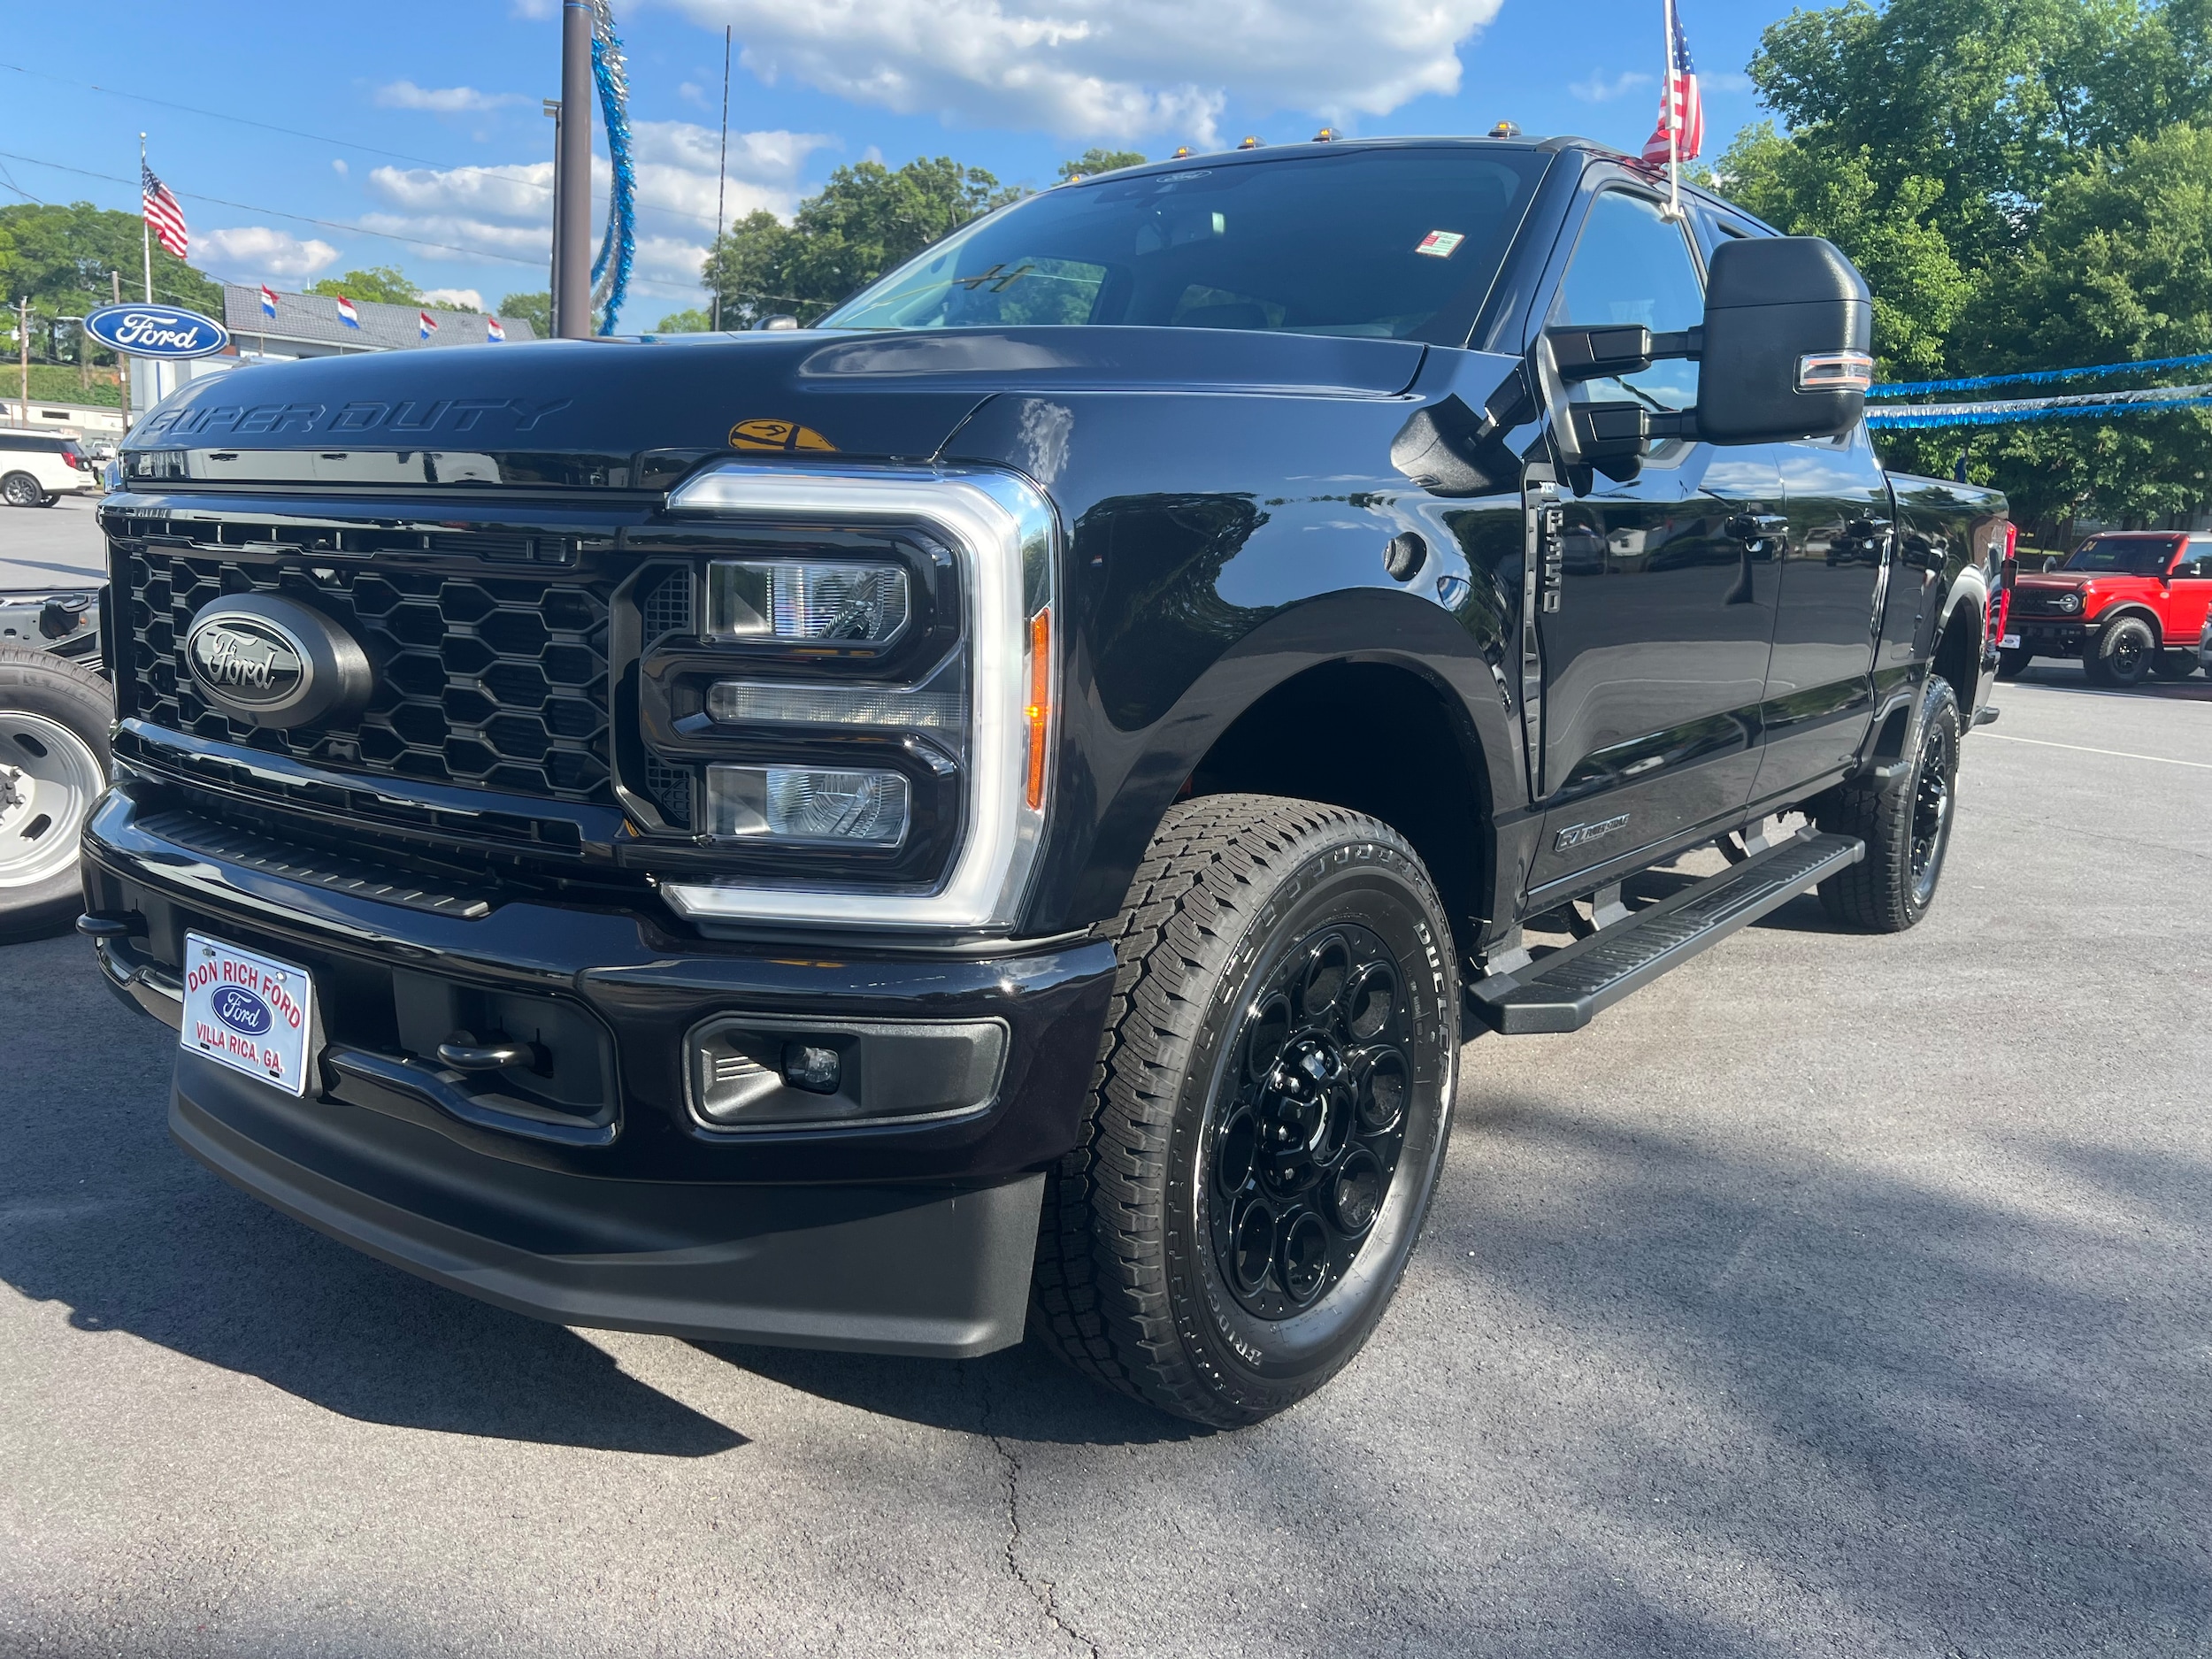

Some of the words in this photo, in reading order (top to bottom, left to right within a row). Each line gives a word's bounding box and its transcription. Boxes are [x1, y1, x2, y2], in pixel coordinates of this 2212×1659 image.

[116, 313, 199, 349] Ford
[142, 403, 326, 435] SUPER
[328, 398, 574, 432] DUTY
[1540, 481, 1555, 494] XLT
[208, 630, 278, 690] Ford
[188, 960, 219, 993] DON
[223, 960, 259, 990] RICH
[262, 976, 301, 1029] FORD
[223, 991, 260, 1027] Ford
[196, 1020, 225, 1048] VILLA
[229, 1035, 260, 1067] RICA,
[263, 1048, 284, 1073] GA.
